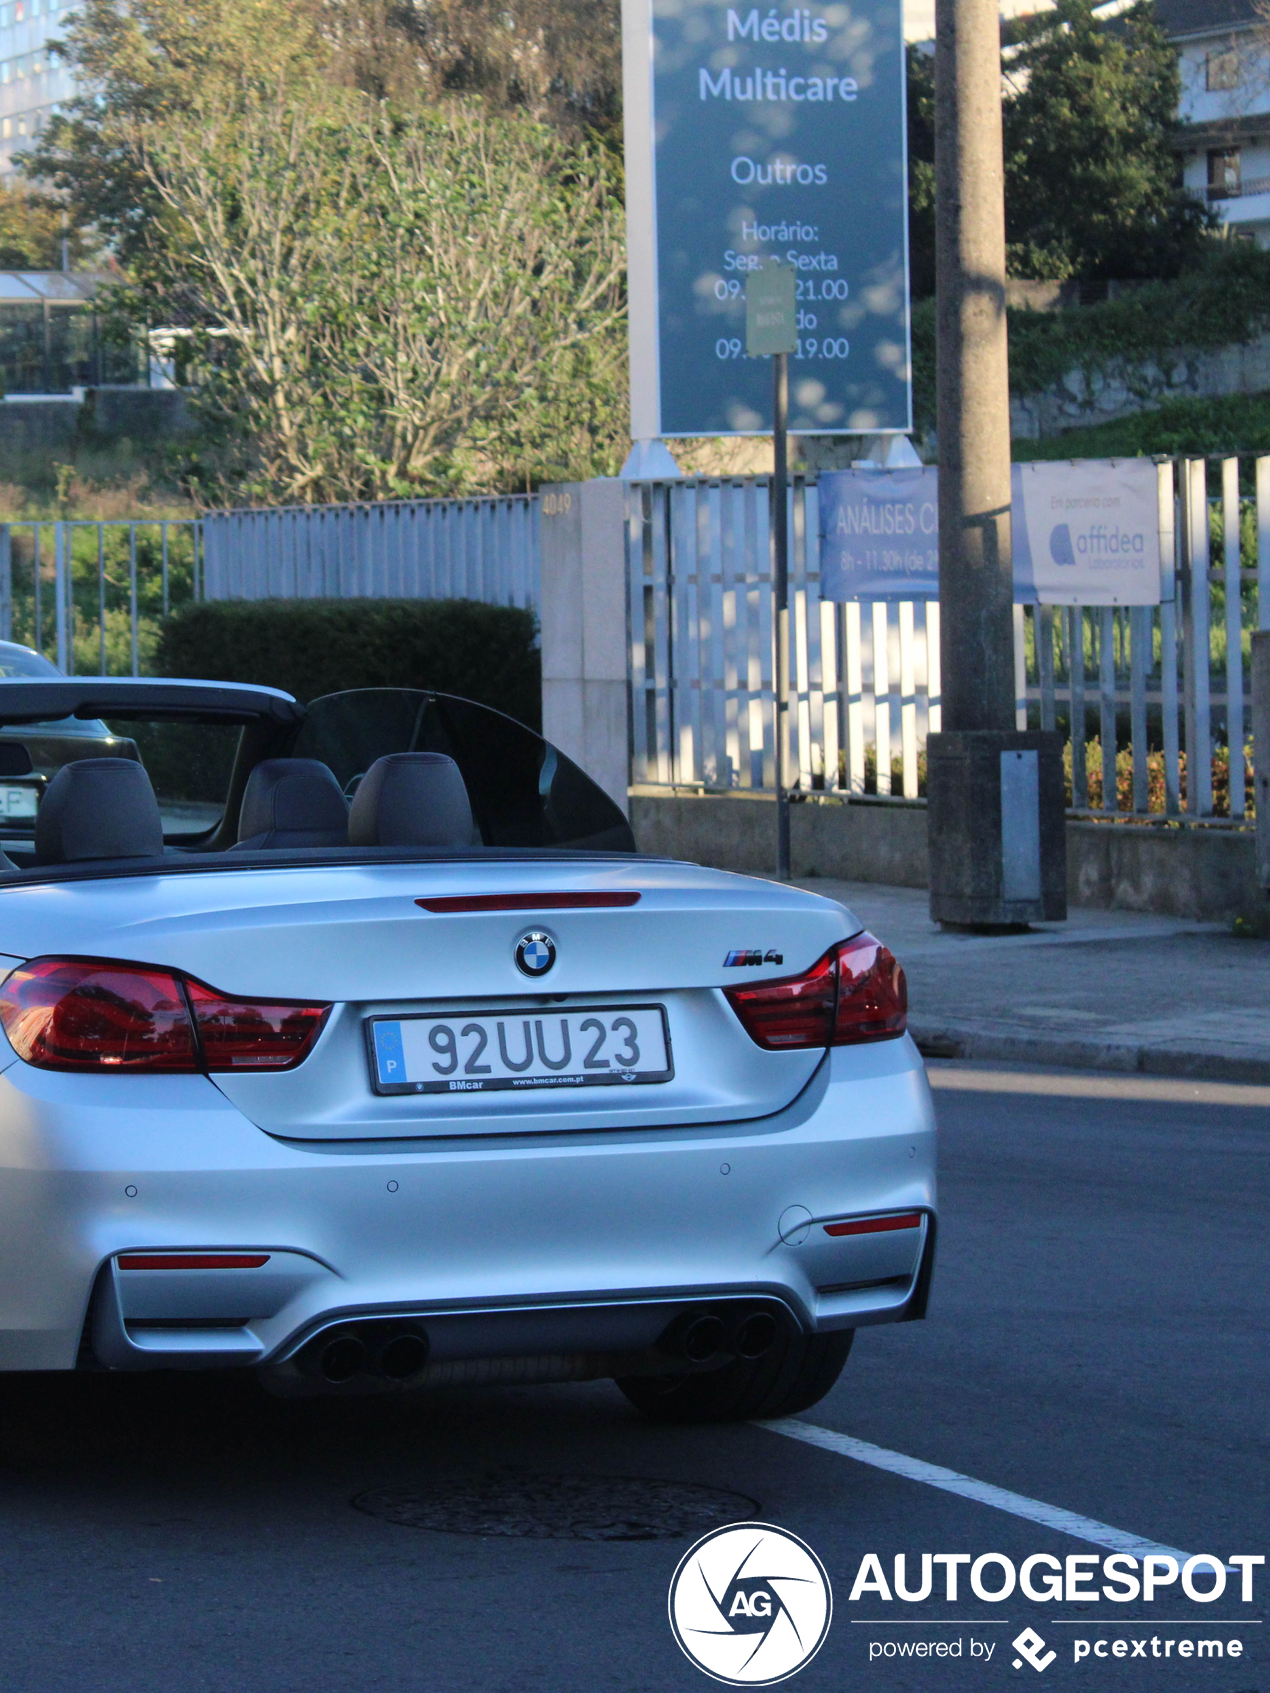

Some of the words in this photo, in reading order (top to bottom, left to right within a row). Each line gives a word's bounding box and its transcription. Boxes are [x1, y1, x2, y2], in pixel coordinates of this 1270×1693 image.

[727, 8, 828, 42] Médis
[699, 67, 859, 101] Multicare
[731, 156, 828, 185] Outros
[742, 220, 819, 242] Horário:
[837, 498, 915, 534] ANÁLISES
[1077, 525, 1144, 554] affidea
[723, 949, 783, 967] M4
[386, 1060, 397, 1073] P
[449, 1080, 484, 1091] BMcar
[512, 1076, 585, 1086] www.bmcar.com.pt
